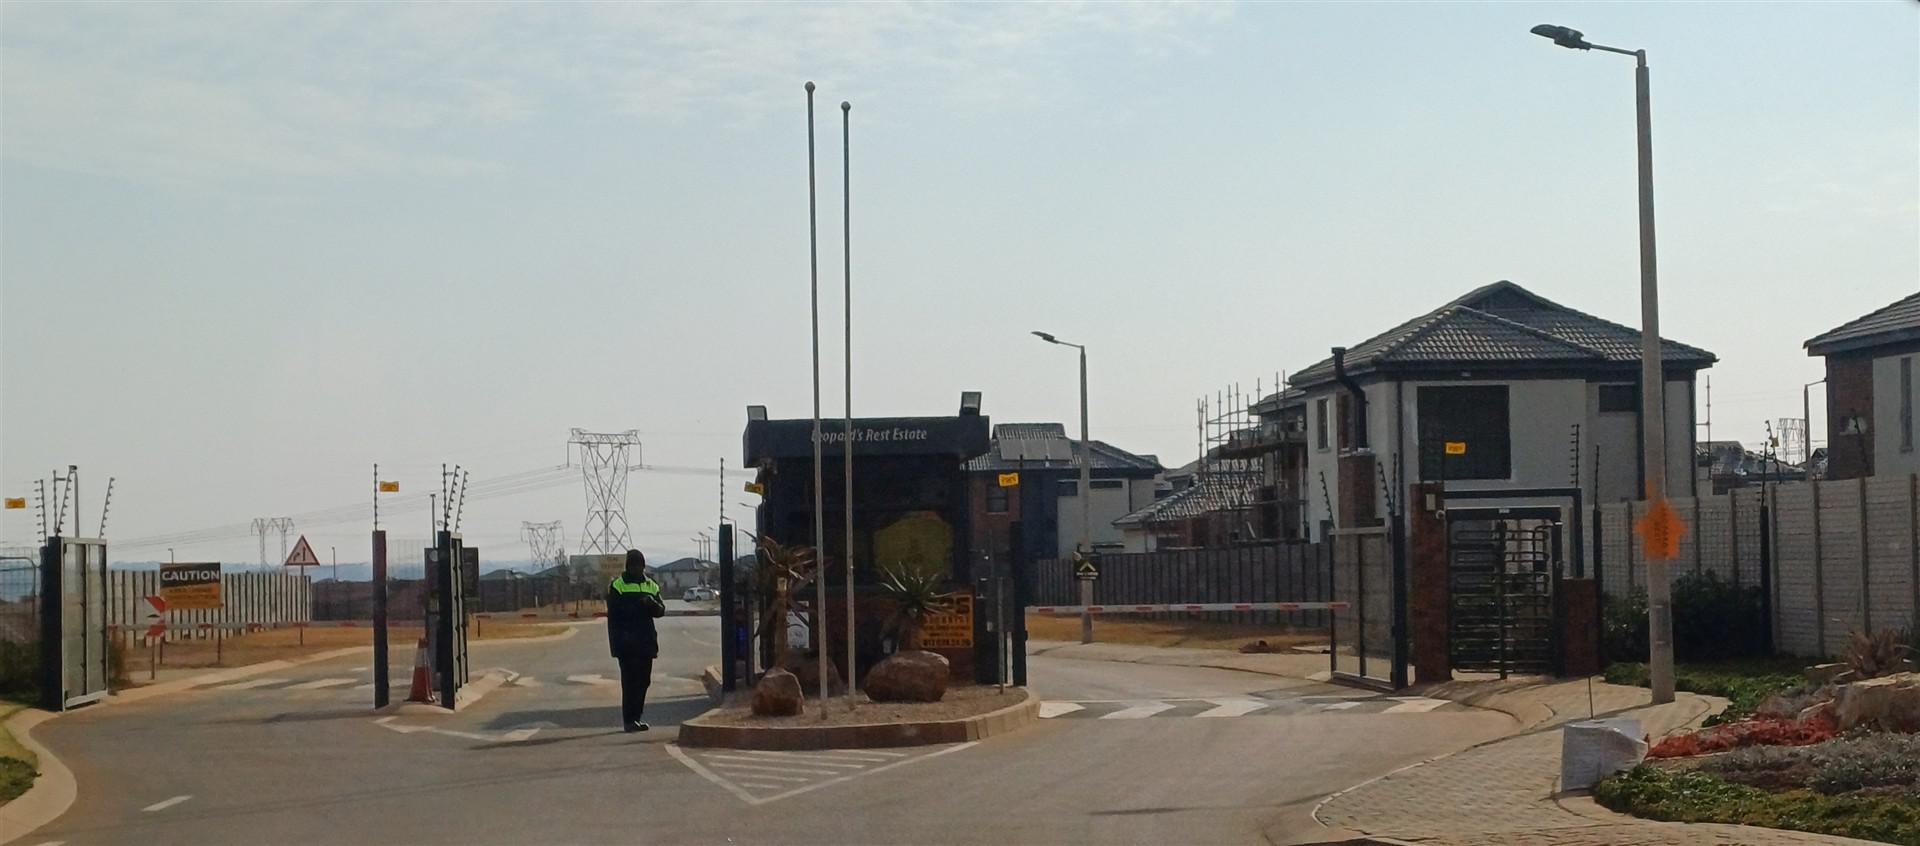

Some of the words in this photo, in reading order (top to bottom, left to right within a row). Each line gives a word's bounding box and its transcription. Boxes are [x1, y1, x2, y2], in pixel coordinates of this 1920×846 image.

[865, 428, 890, 442] Rest
[893, 427, 927, 441] Estate
[161, 570, 220, 581] CAUTION
